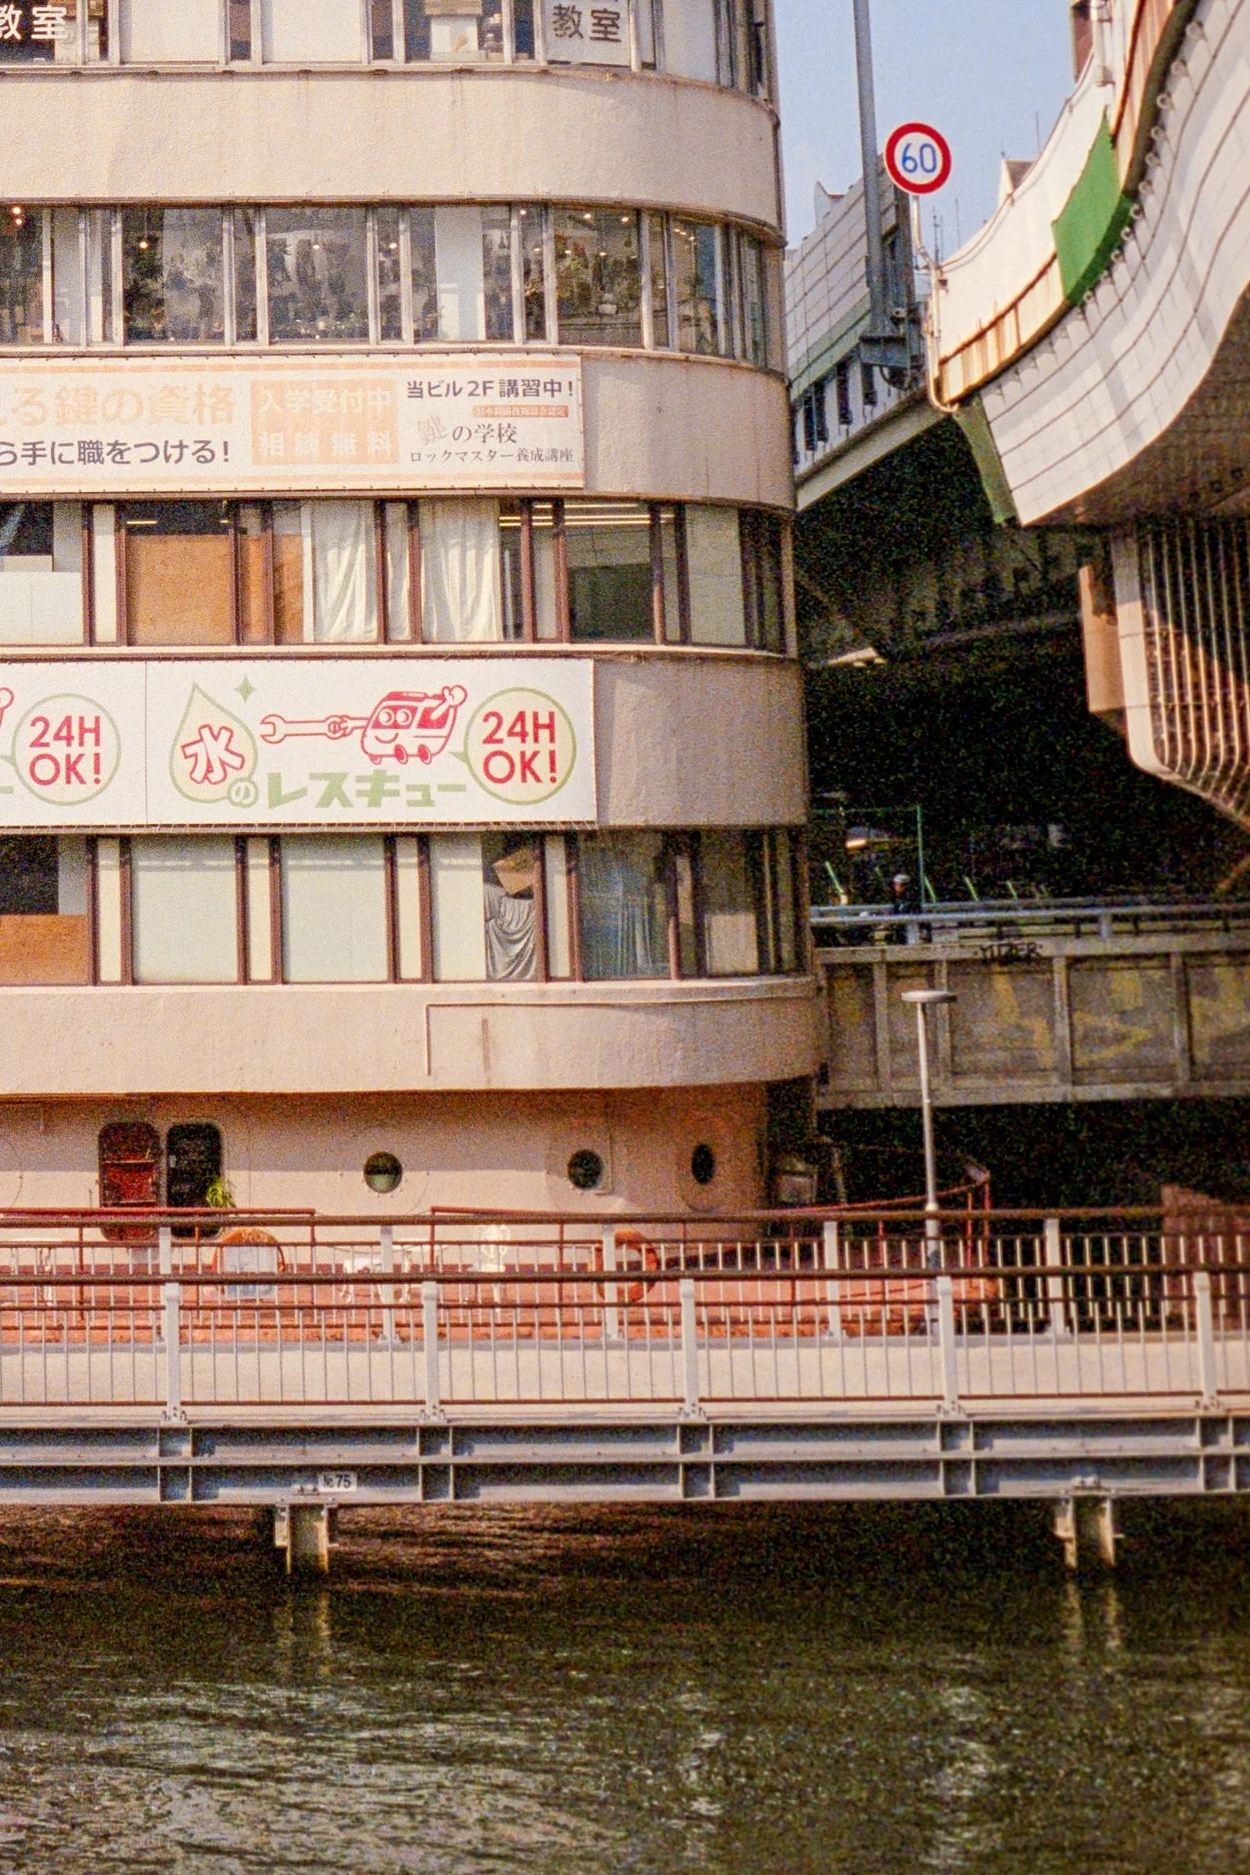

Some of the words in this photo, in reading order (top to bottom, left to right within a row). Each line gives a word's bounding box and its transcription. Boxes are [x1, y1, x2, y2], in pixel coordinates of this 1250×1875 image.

[552, 4, 622, 44] 教室
[901, 141, 938, 175] 60
[257, 387, 393, 415] 入学受付中
[410, 447, 574, 463] ロックマスター養成講座
[29, 715, 101, 748] 24H
[481, 711, 556, 745] 24H
[29, 753, 101, 786] OK!
[181, 724, 468, 809] 水のレスキュー
[482, 750, 558, 785] OK!
